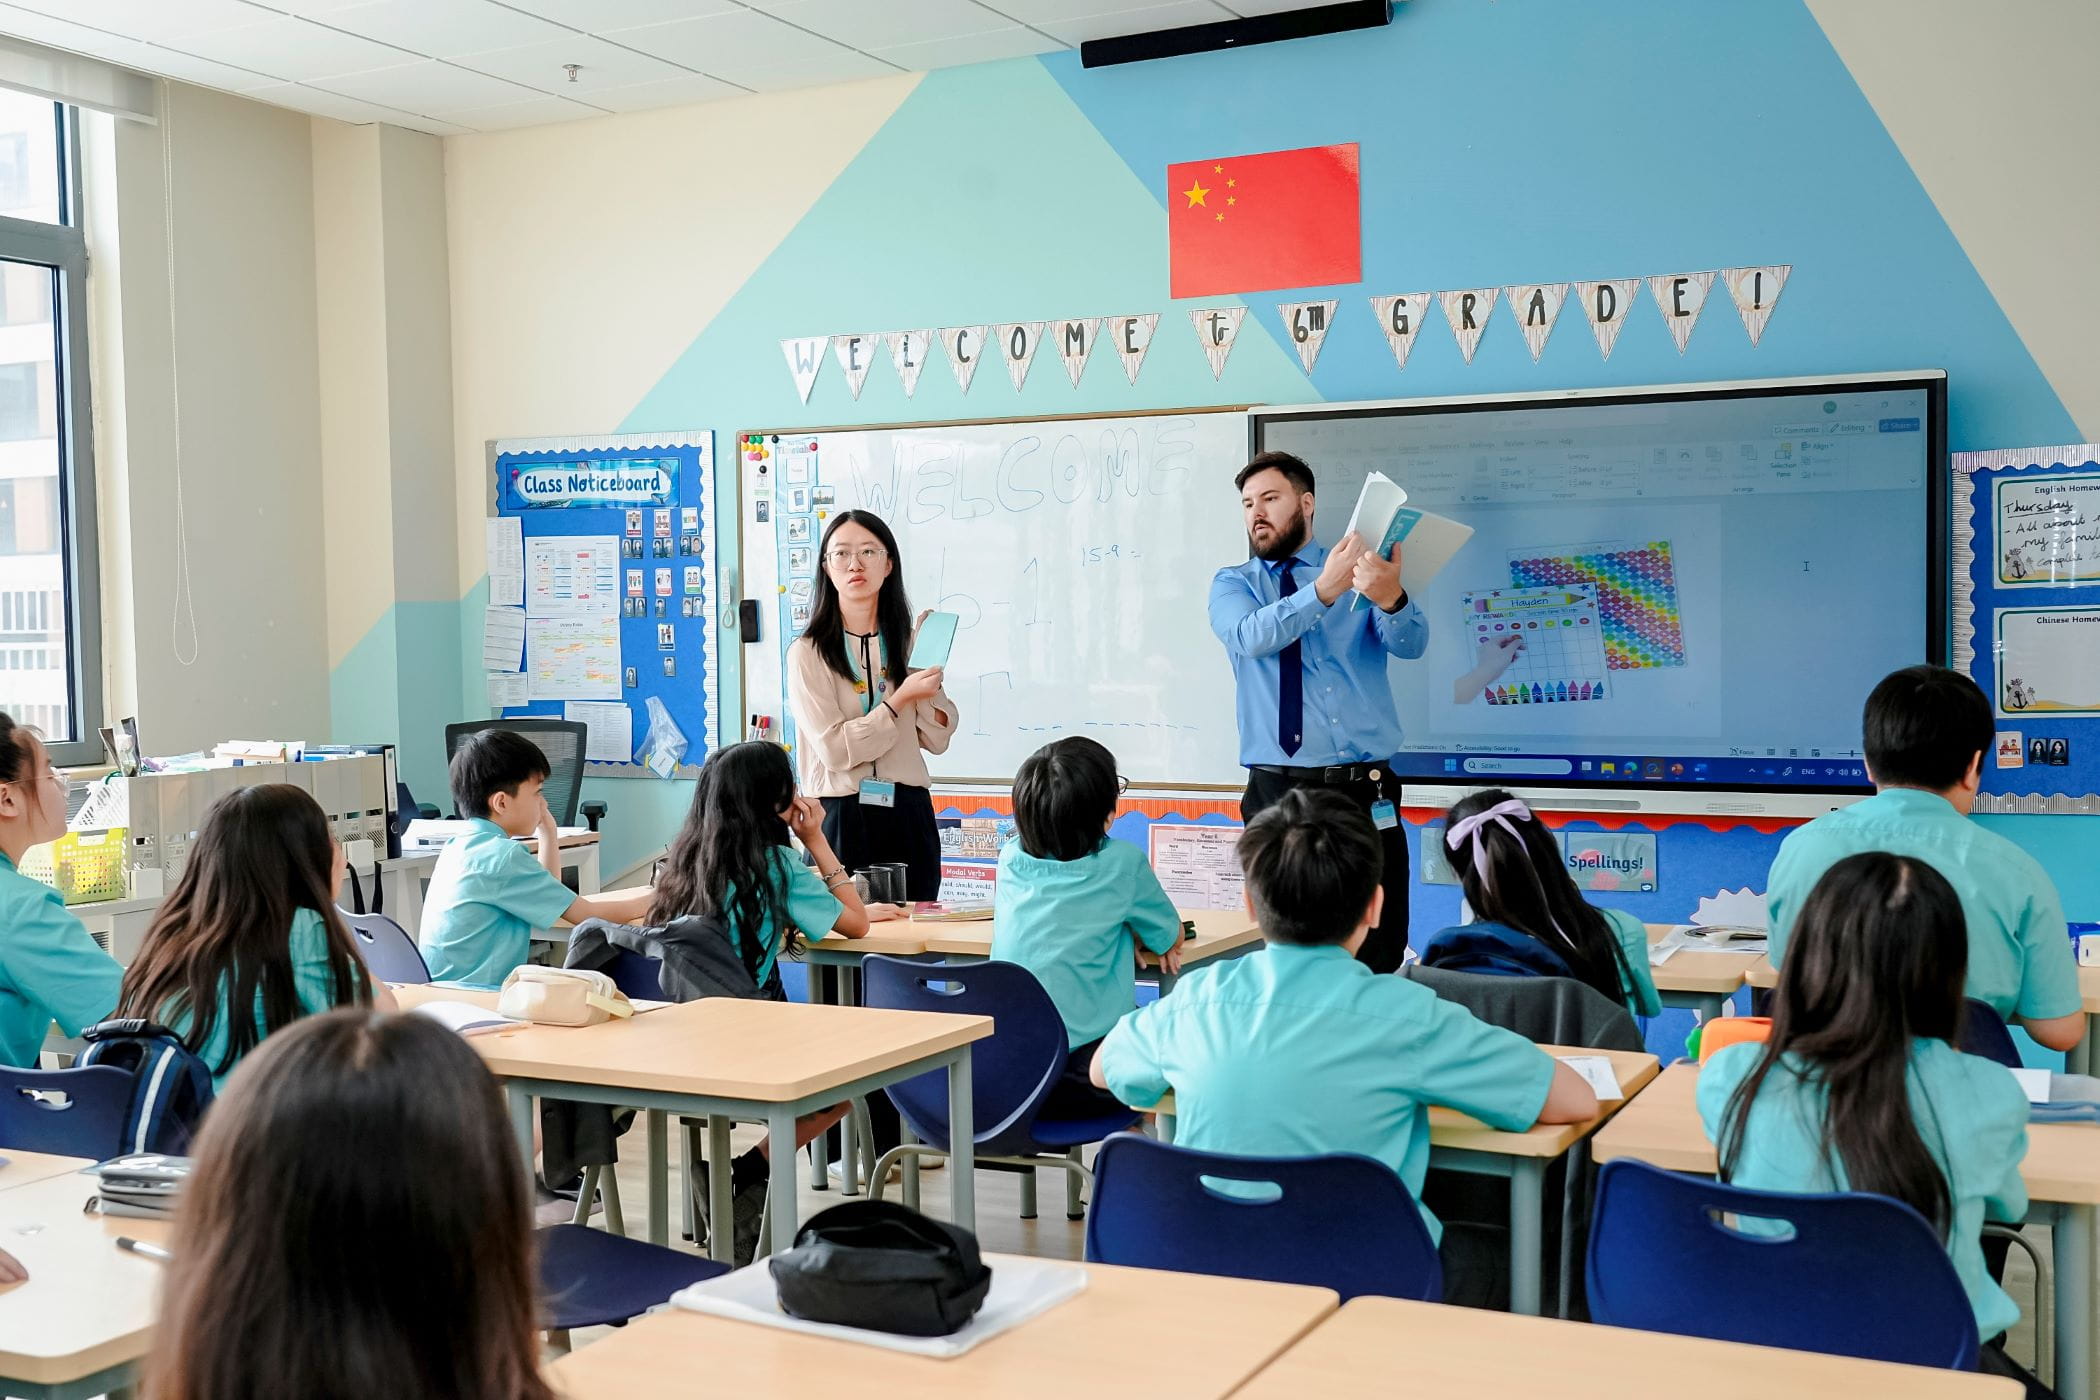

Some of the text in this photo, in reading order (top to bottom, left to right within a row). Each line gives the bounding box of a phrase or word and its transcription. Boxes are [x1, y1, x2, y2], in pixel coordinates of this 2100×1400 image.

[794, 317, 1139, 375] WELCOME
[849, 419, 1196, 525] WELCOME
[524, 470, 662, 494] Class Noticeboard
[2034, 485, 2066, 495] English
[2003, 499, 2074, 515] Thursday
[2016, 521, 2038, 535] All
[2021, 527, 2100, 552] my famil
[1511, 597, 1549, 608] Hayden
[2036, 616, 2070, 624] Chinese
[943, 832, 981, 844] English
[1569, 854, 1643, 873] Spellings!
[946, 868, 986, 877] Modal Verbs
